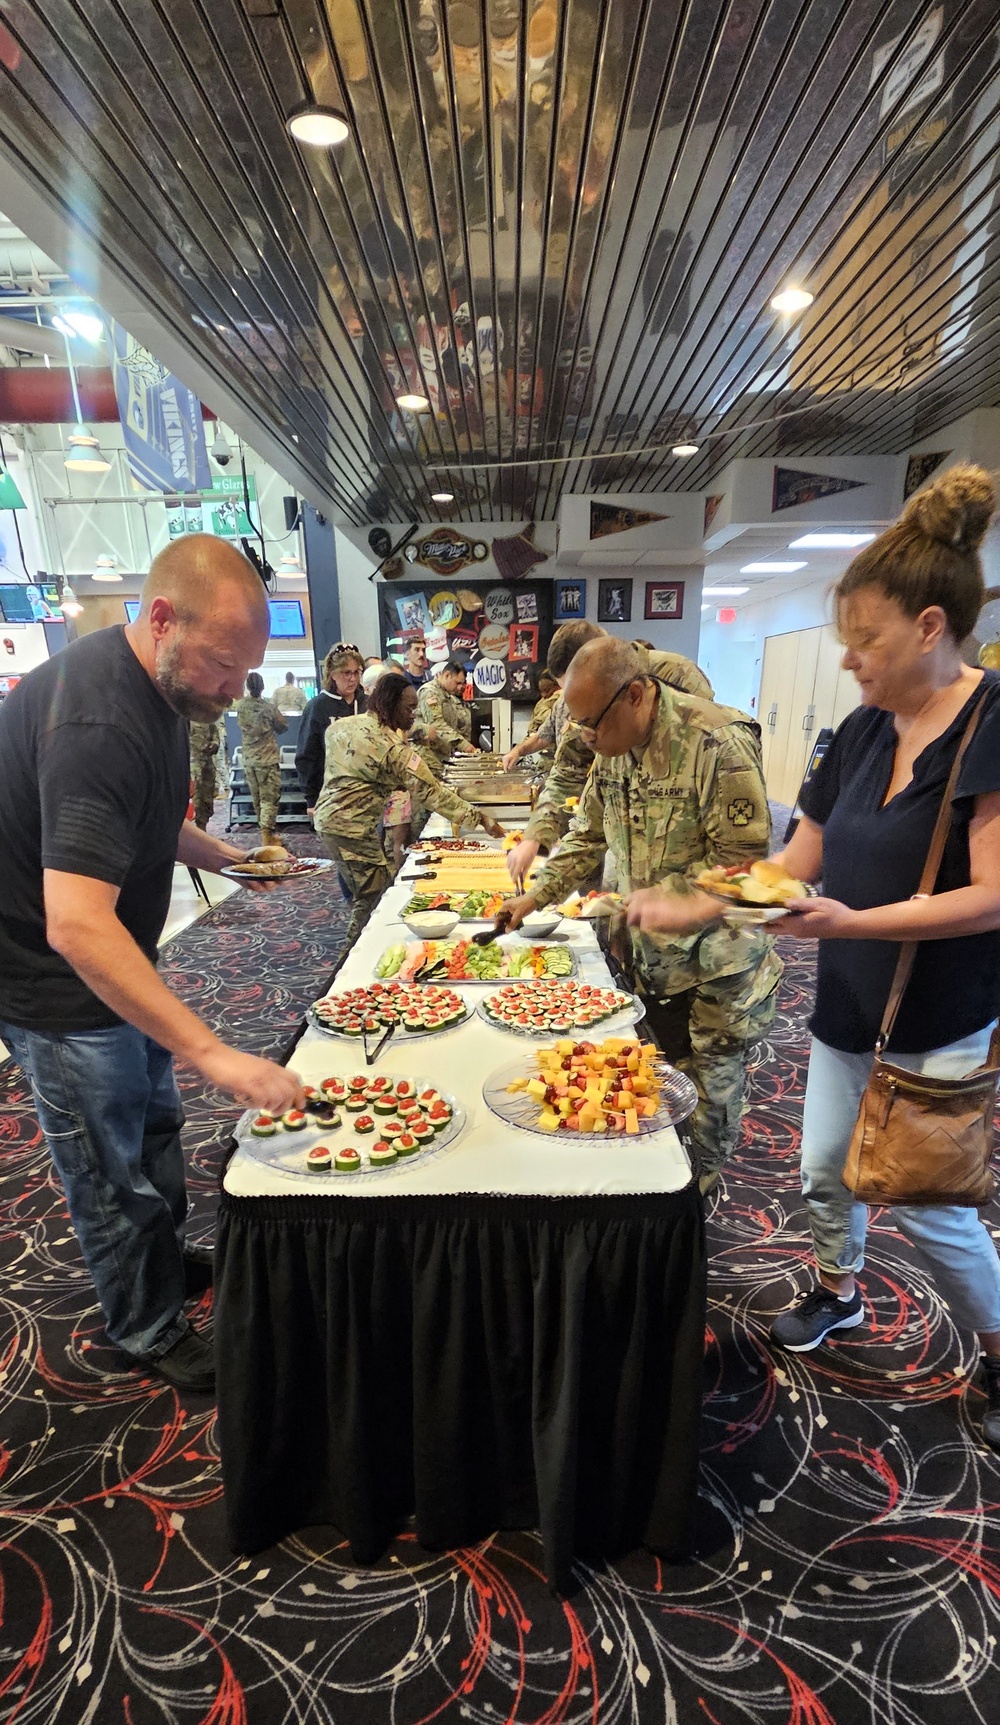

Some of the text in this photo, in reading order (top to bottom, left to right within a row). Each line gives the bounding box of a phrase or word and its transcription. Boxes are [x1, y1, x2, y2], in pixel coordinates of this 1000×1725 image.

[160, 387, 190, 479] VIKINGS
[491, 608, 509, 620] Sox
[470, 648, 479, 660] 7
[477, 664, 506, 686] MAGIC
